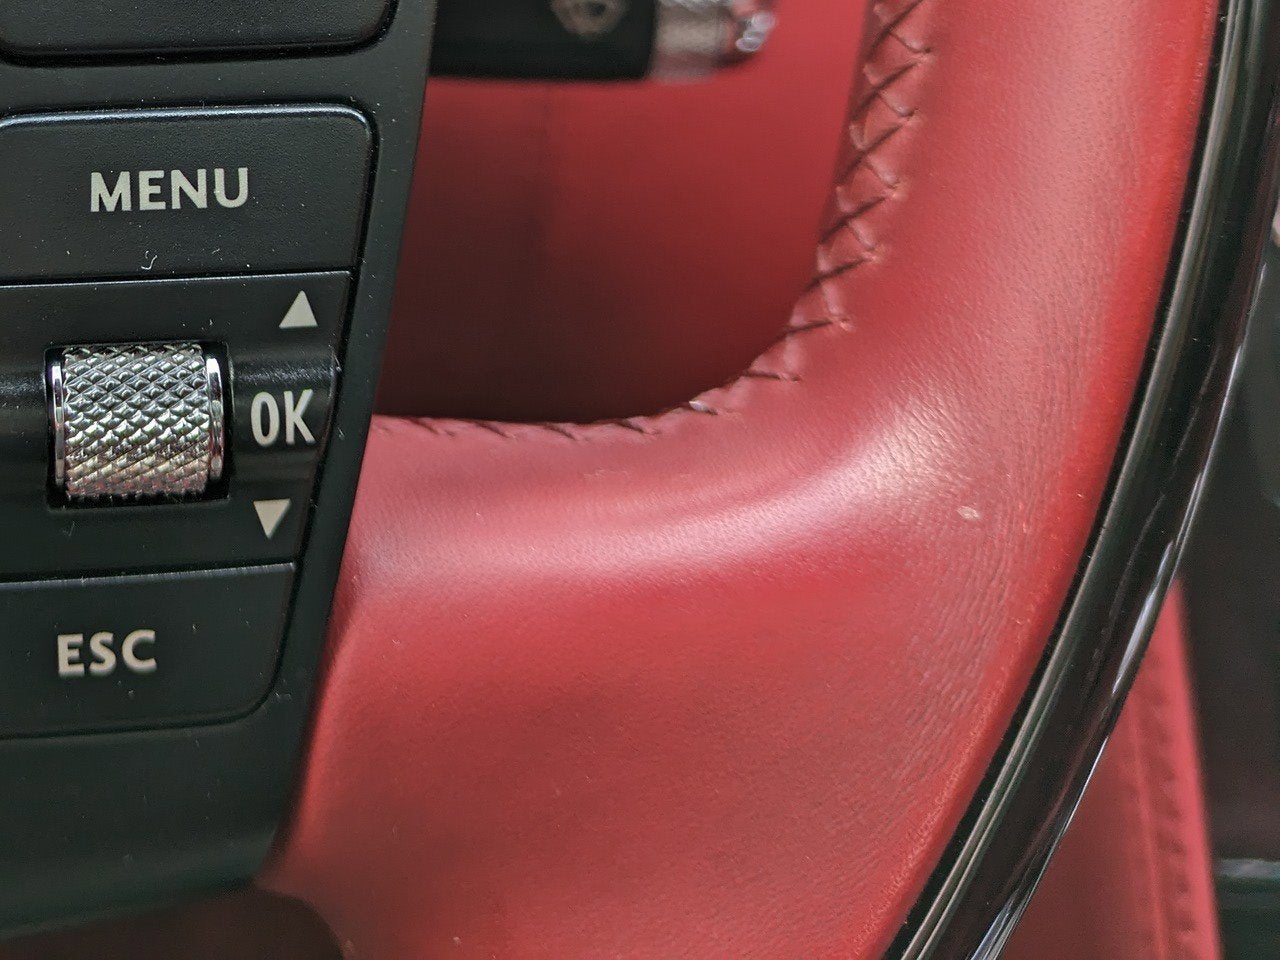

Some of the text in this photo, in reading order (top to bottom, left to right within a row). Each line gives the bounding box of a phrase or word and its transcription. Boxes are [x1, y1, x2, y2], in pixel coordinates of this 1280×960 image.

[90, 167, 249, 213] MENU
[250, 388, 315, 446] OK
[57, 630, 157, 676] ESC
